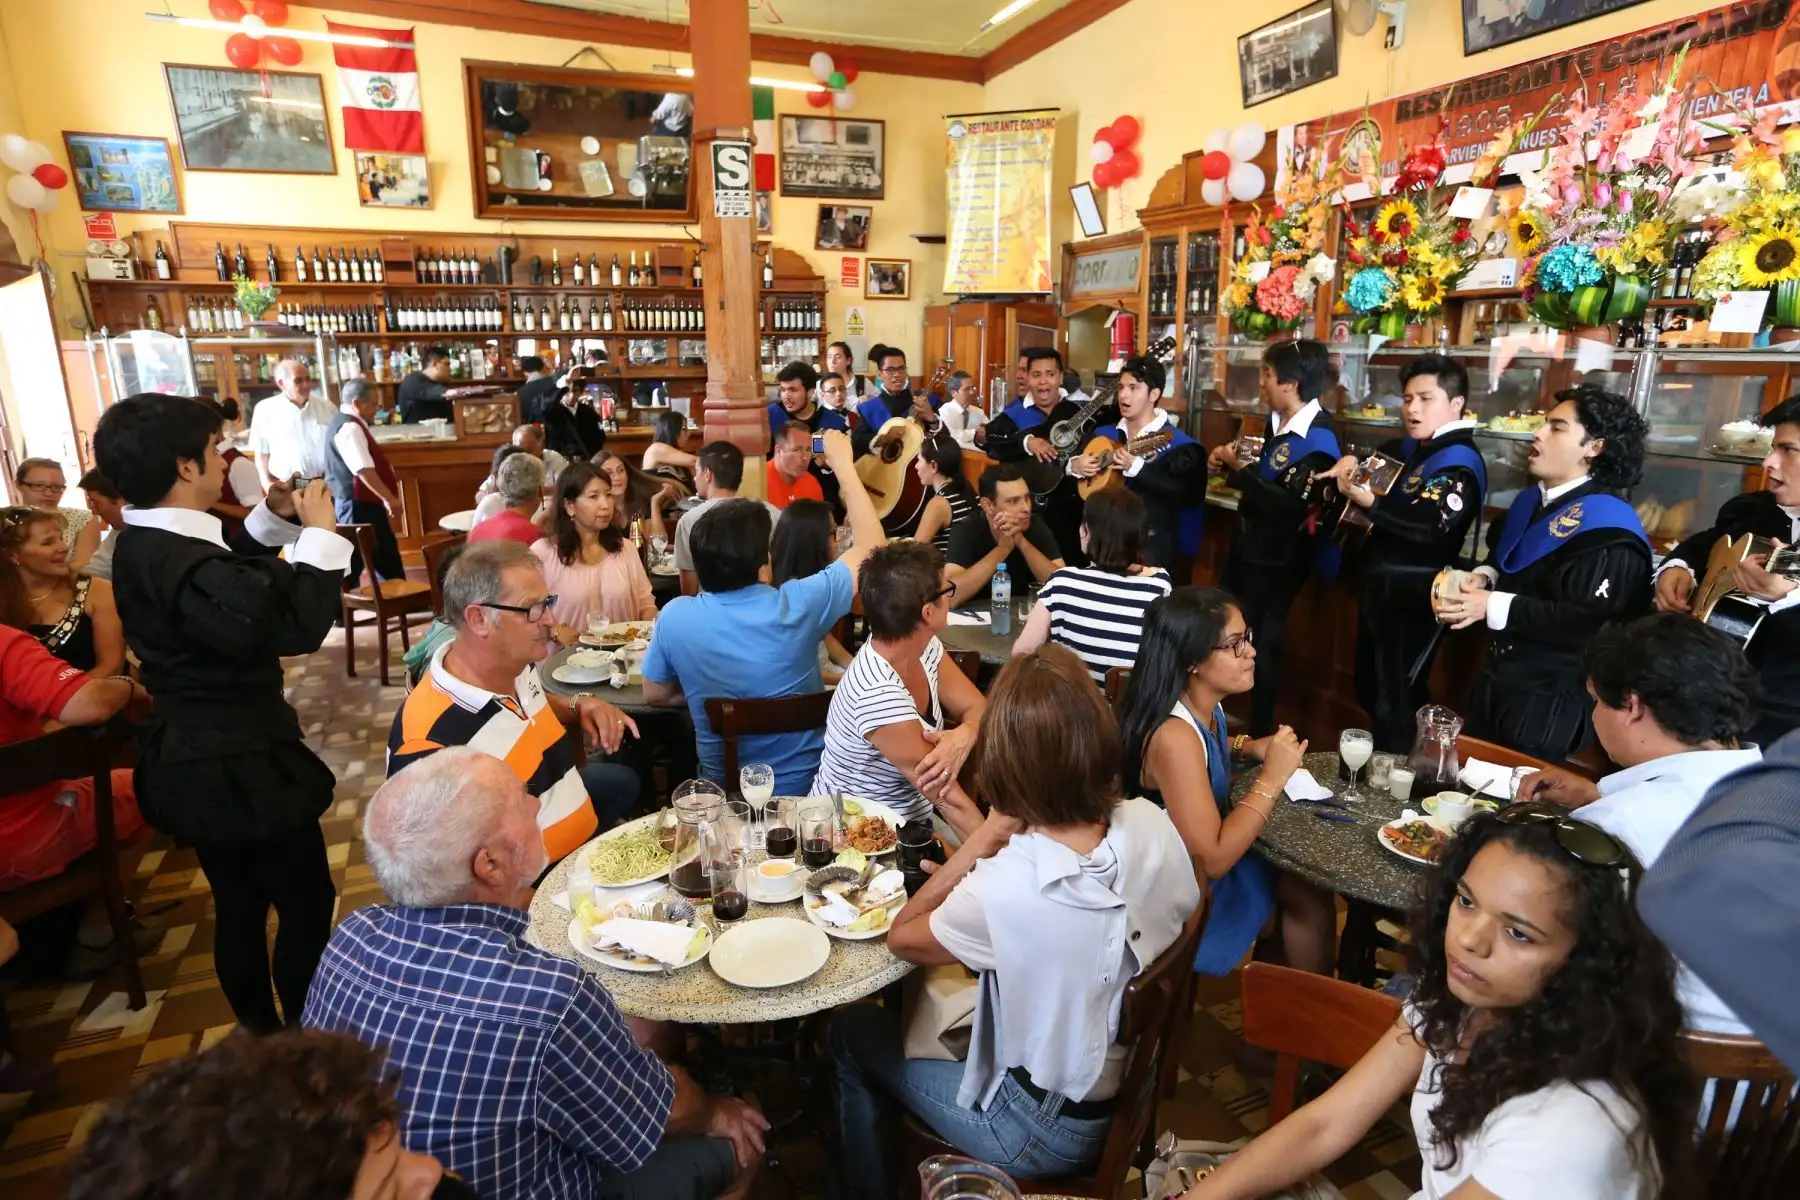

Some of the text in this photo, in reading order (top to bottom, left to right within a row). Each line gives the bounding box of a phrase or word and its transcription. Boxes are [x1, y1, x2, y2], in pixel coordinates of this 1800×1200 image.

[1396, 1, 1788, 123] RESTAURANTE CORDANO
[968, 120, 1018, 134] RESTAURANTE
[1439, 105, 1512, 141] 1905
[718, 147, 749, 187] S
